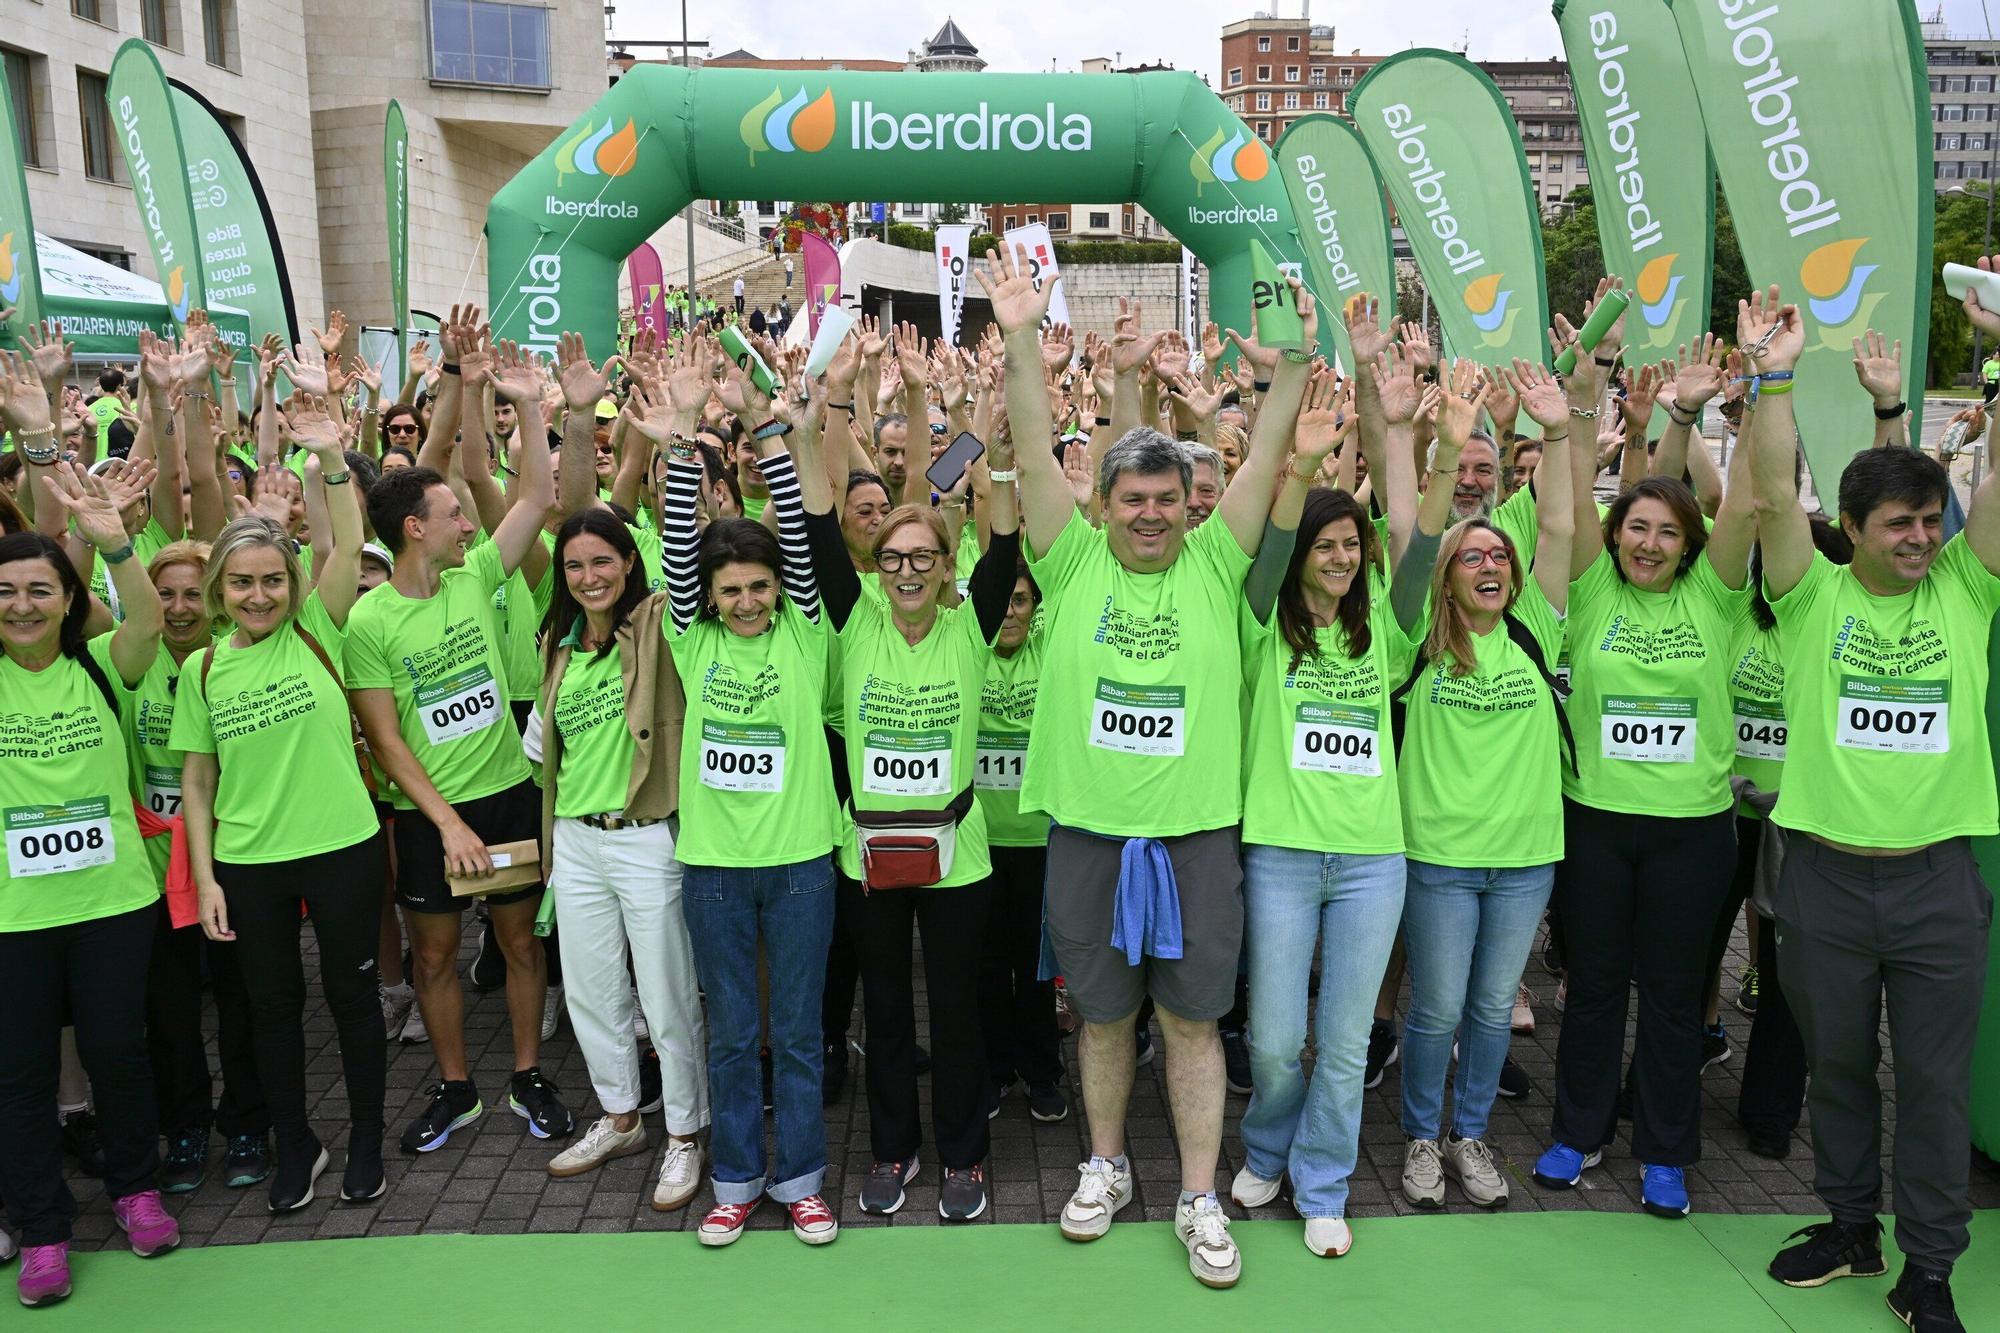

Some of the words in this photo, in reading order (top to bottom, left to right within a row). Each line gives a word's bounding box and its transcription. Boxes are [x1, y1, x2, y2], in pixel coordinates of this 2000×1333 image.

[851, 101, 1093, 151] Iberdrola
[546, 196, 639, 219] Iberdrola
[1188, 204, 1278, 224] Iberdrola
[216, 325, 247, 347] ÁNCER
[1094, 595, 1113, 643] BILBAO
[1600, 615, 1623, 651] BILBAO
[1832, 615, 1856, 660] BILBAO
[458, 644, 489, 664] cáncer
[1136, 650, 1147, 660] el
[1651, 653, 1663, 663] el
[1842, 654, 1886, 675] contra
[1889, 665, 1902, 677] el
[278, 681, 309, 699] aurka
[1101, 684, 1126, 698] Bilbao
[1506, 677, 1534, 689] aurka
[1737, 680, 1771, 699] contra
[1847, 681, 1880, 692] Bilbao
[274, 690, 313, 710] marcha
[418, 687, 445, 700] Bilbao
[705, 694, 741, 713] contra
[1336, 689, 1347, 699] el
[1502, 687, 1536, 700] marcha
[432, 689, 495, 728] 0005
[866, 702, 907, 715] martxan
[911, 709, 922, 717] en
[925, 702, 960, 715] marcha
[1302, 707, 1331, 717] Bilbao
[1439, 697, 1480, 711] contra
[1484, 703, 1495, 711] el
[1499, 699, 1537, 711] cáncer
[1607, 700, 1636, 709] Bilbao
[65, 715, 98, 731] aurka
[137, 699, 150, 744] BILBAO
[218, 722, 256, 743] contra
[258, 718, 271, 729] el
[273, 700, 317, 723] cáncer
[867, 715, 905, 728] contra
[907, 719, 918, 729] el
[921, 714, 960, 728] cáncer
[1101, 710, 1174, 738] 0002
[1850, 707, 1937, 735] 0007
[60, 724, 102, 741] marcha
[869, 734, 895, 744] Bilbao
[1612, 723, 1686, 746] 0017
[41, 746, 54, 758] el
[58, 737, 103, 754] cáncer
[1305, 731, 1373, 759] 0004
[706, 749, 773, 775] 0003
[873, 756, 939, 780] 0001
[10, 811, 45, 822] Bilbao
[20, 827, 104, 858] 0008
